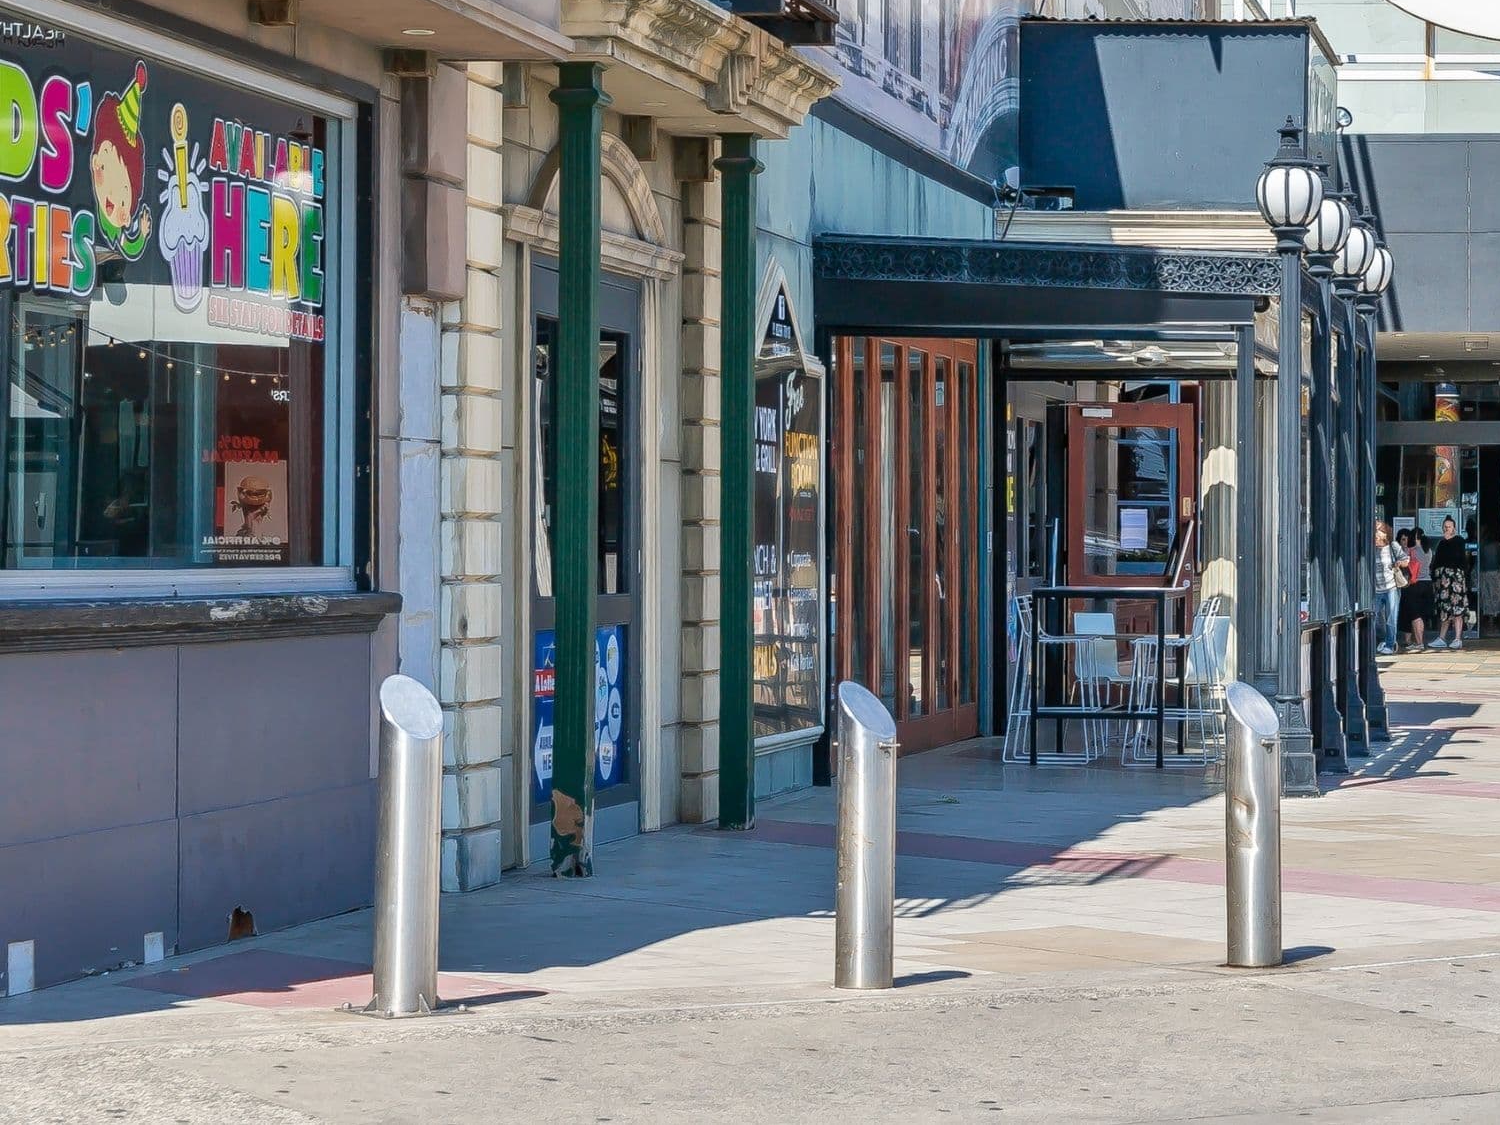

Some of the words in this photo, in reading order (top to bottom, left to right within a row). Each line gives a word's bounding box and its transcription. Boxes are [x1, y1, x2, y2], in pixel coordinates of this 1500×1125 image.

[208, 117, 325, 200] AVAILABLE
[211, 176, 325, 308] HERE
[785, 431, 818, 460] FUNCTION
[791, 463, 812, 490] ROOM
